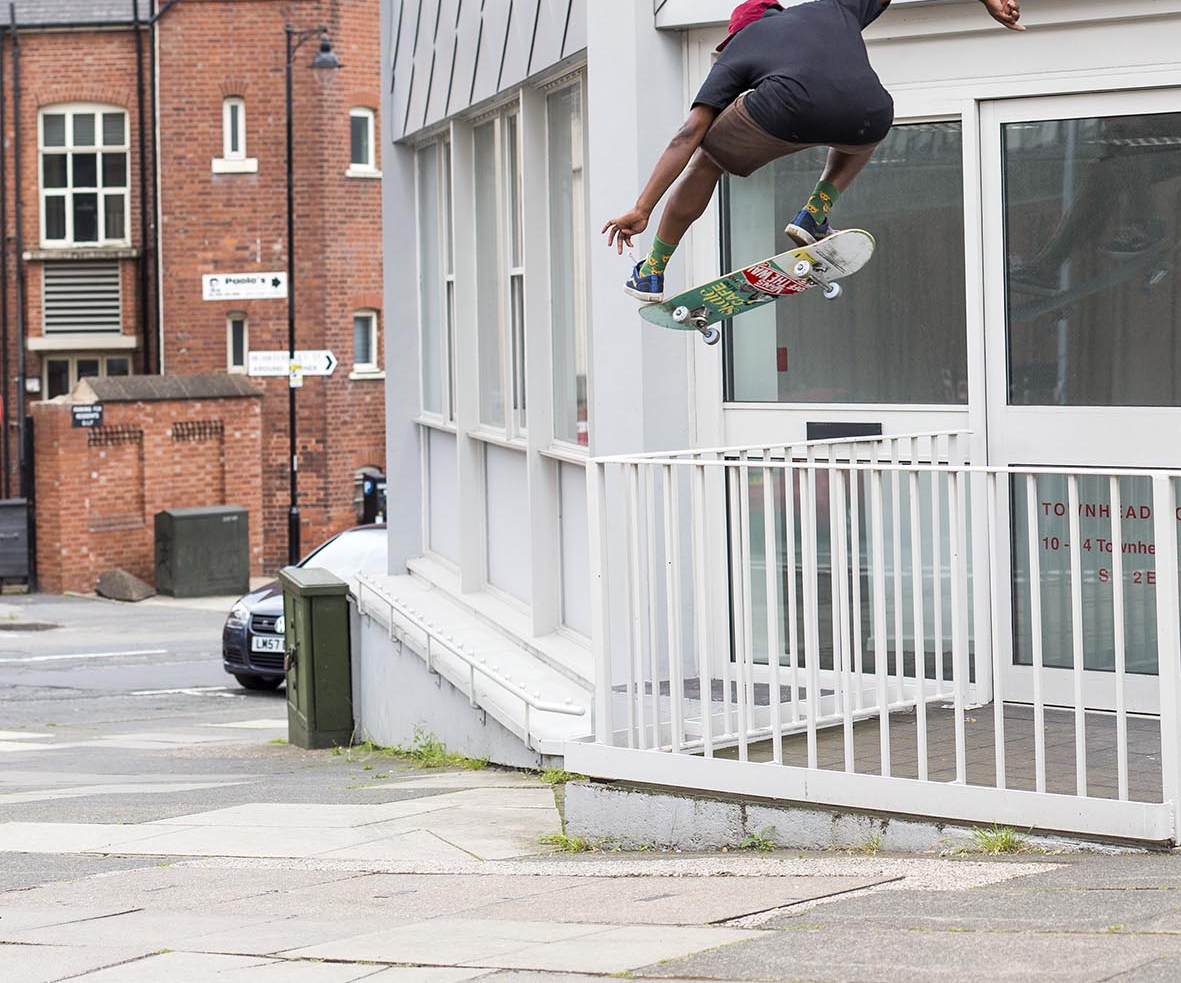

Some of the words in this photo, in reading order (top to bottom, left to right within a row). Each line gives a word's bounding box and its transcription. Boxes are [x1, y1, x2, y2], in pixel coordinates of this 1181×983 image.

[711, 282, 745, 306] CAFE
[1042, 503, 1152, 519] TONHAD
[1043, 537, 1059, 550] 10
[1096, 539, 1156, 554] Tonhe
[1133, 571, 1156, 584] 2E
